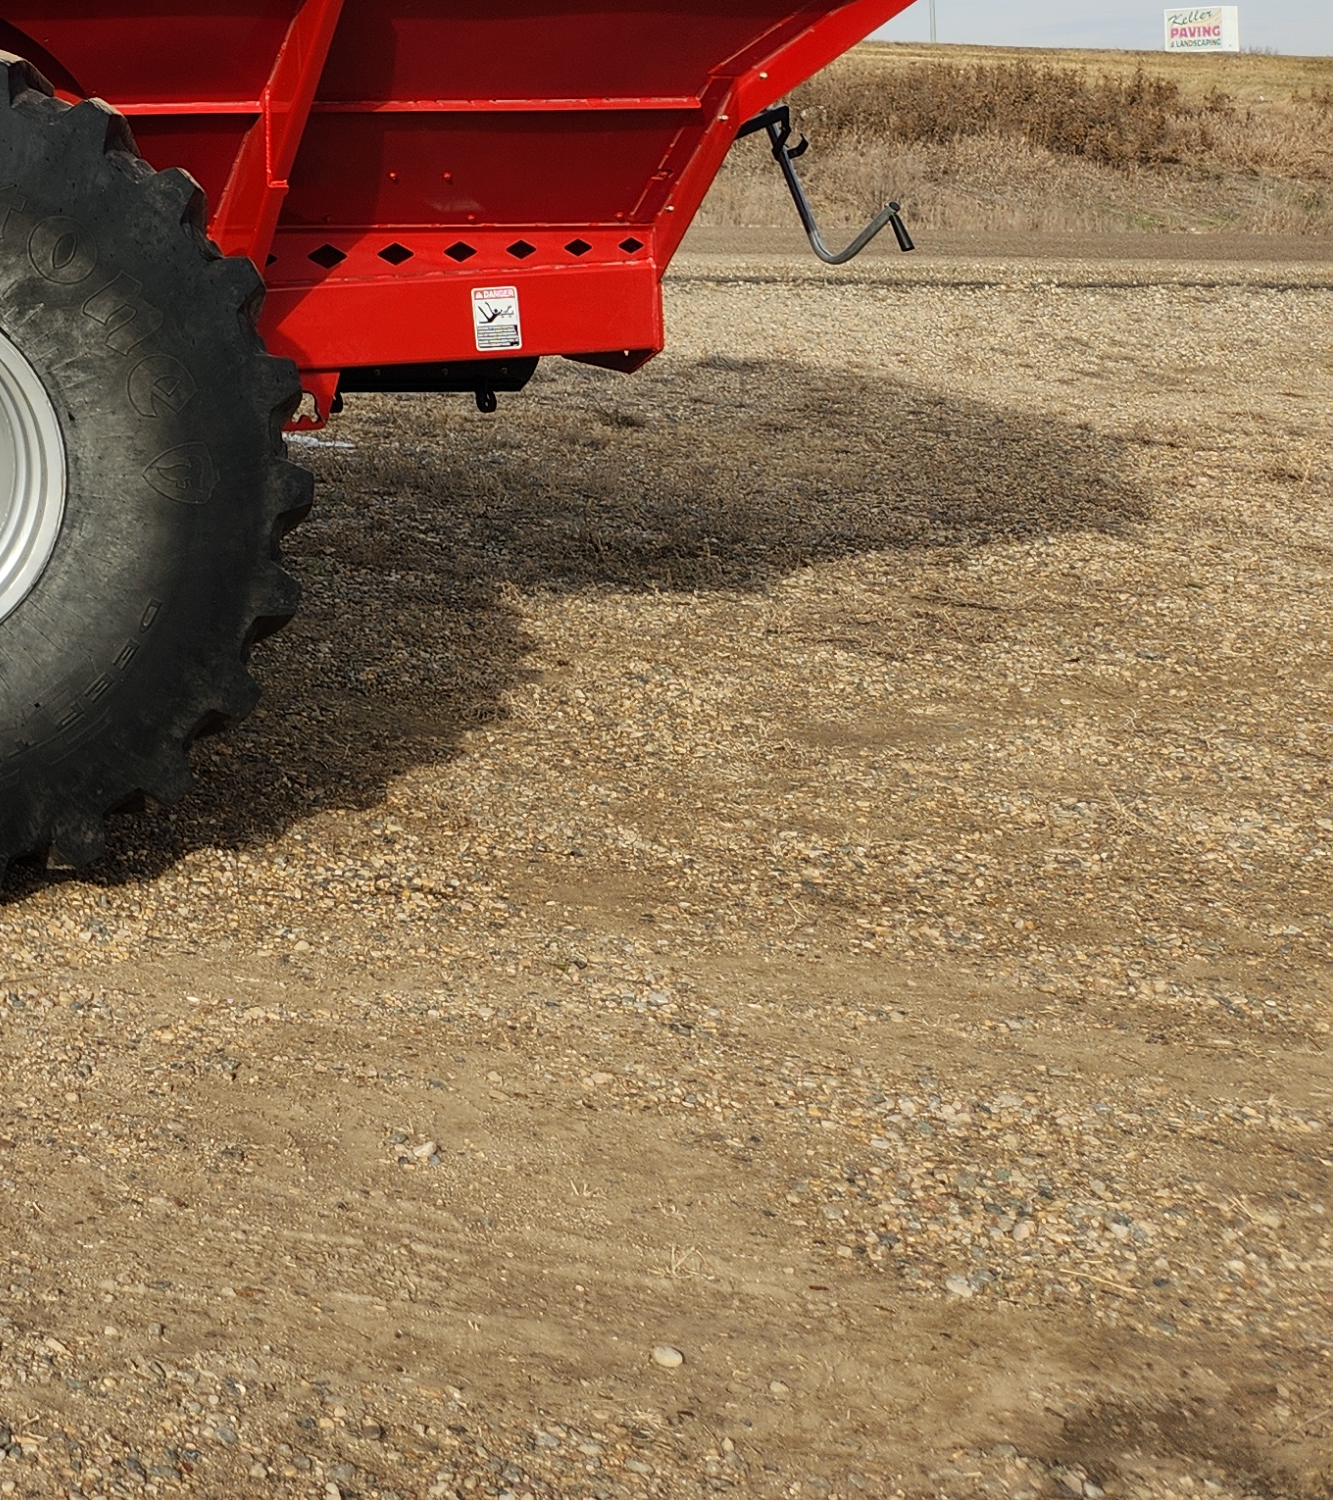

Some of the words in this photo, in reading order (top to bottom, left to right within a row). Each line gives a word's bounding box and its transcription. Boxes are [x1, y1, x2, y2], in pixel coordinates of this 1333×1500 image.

[1168, 11, 1212, 25] Keller
[1171, 26, 1220, 38] PAVING
[1176, 38, 1221, 48] LANDSCAPING
[483, 289, 514, 299] DANGER
[55, 598, 164, 732] DEEP
